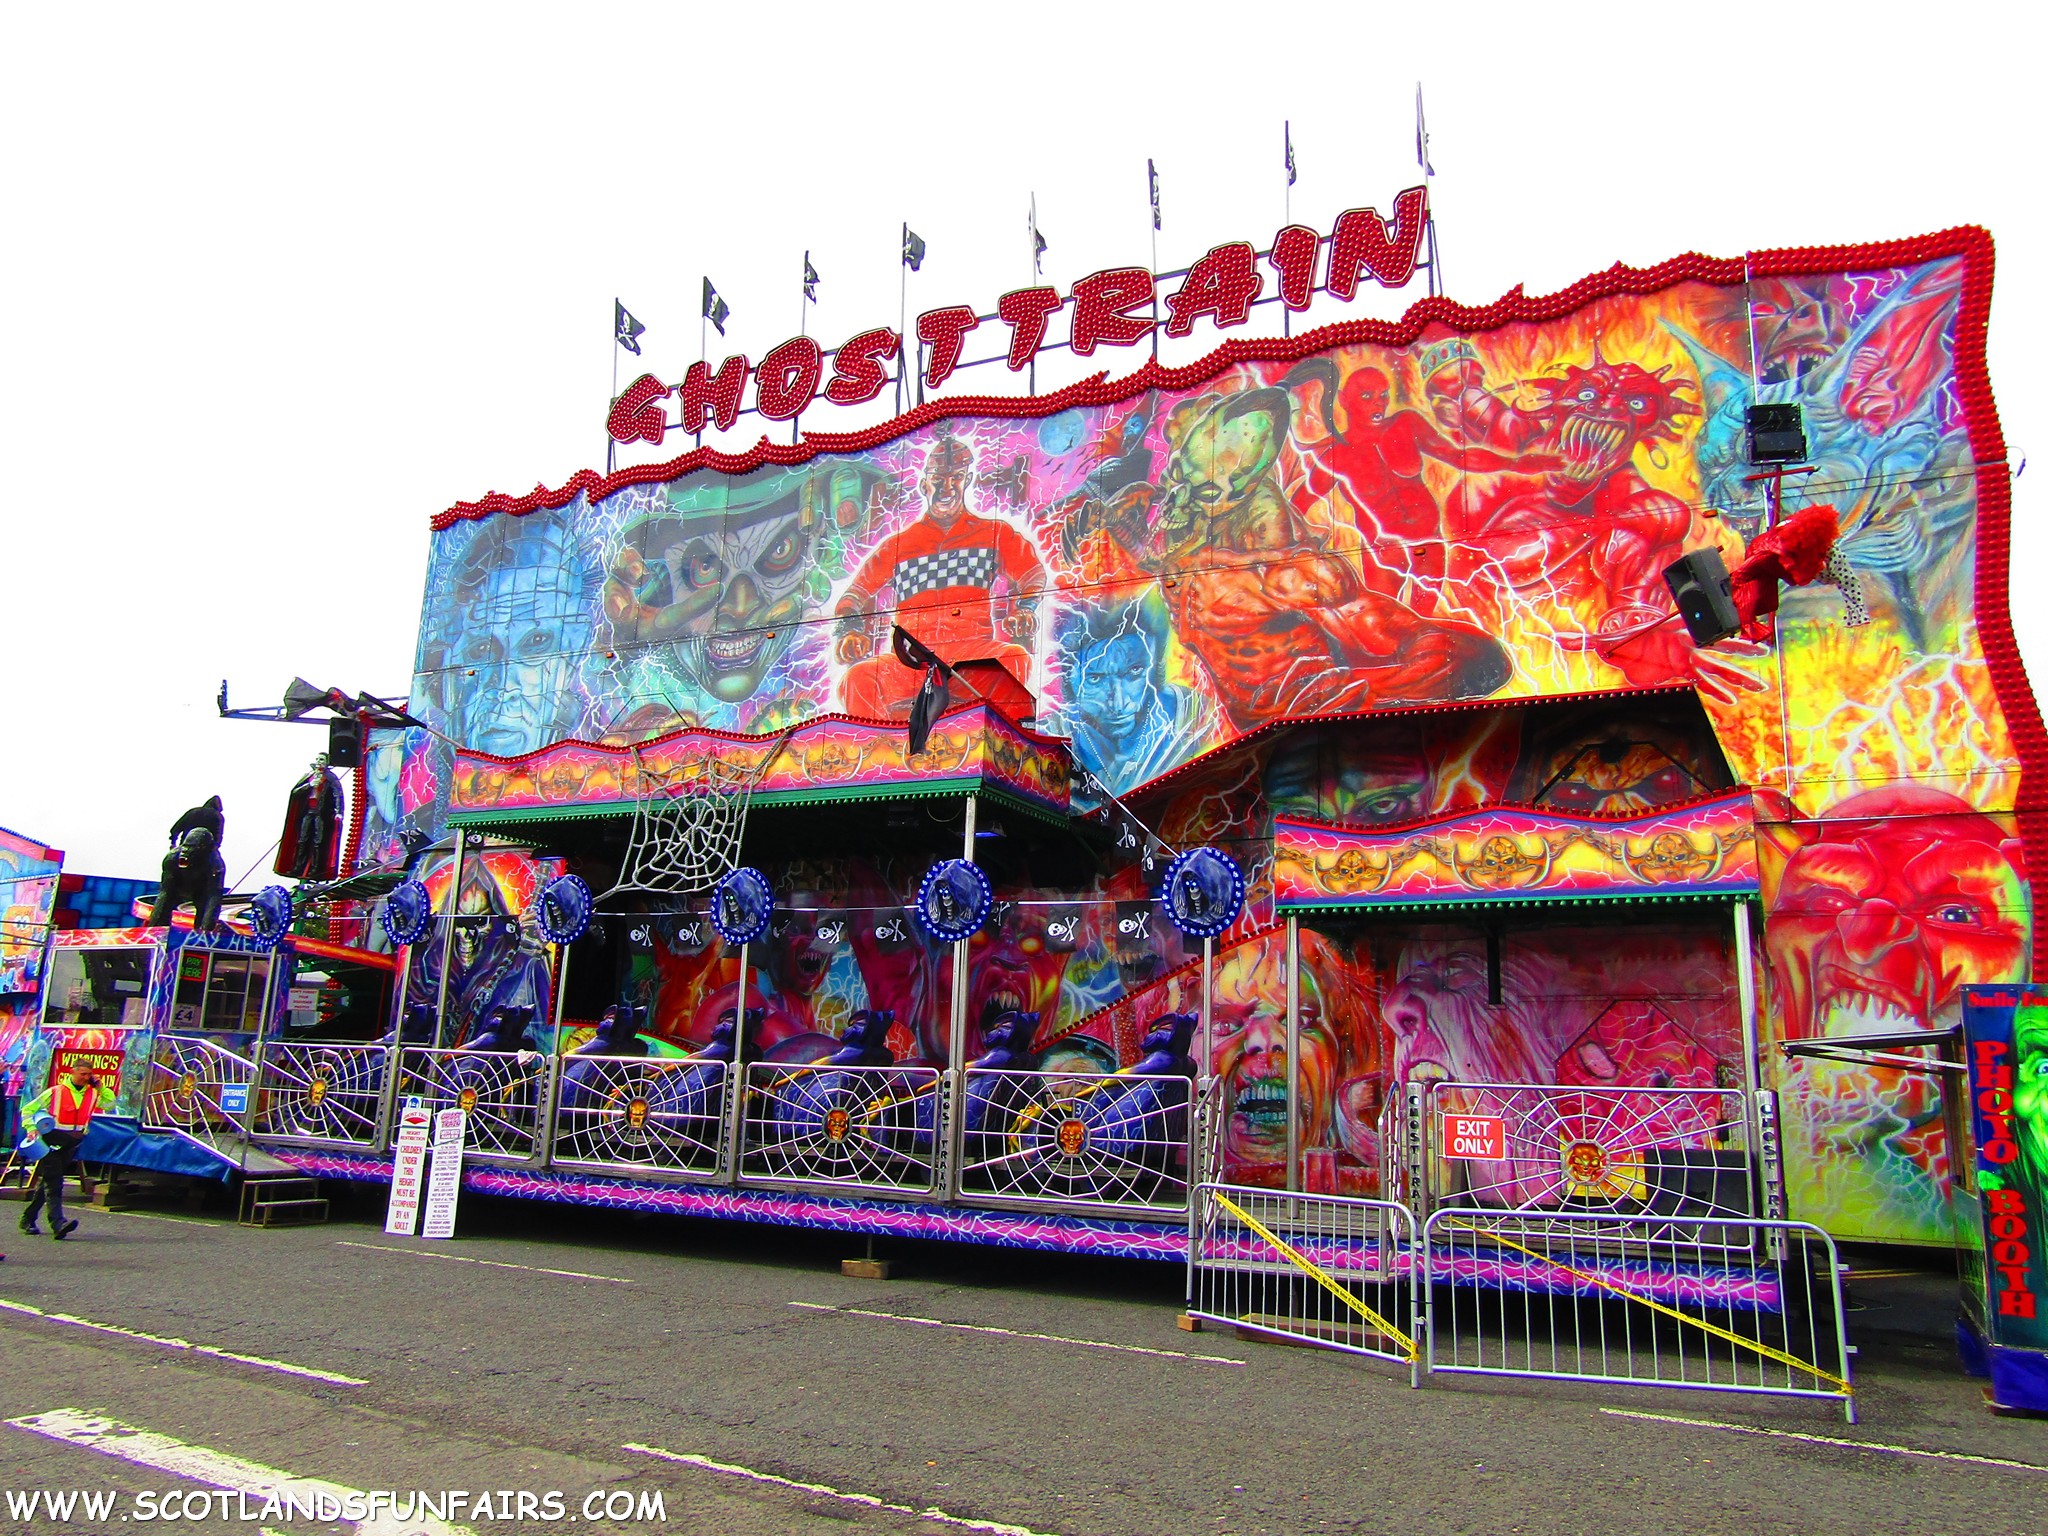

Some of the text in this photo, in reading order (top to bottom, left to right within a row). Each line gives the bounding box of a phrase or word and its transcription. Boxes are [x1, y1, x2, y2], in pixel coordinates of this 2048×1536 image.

[606, 185, 1428, 445] GHOST TRAIN
[182, 928, 272, 953] PAY HER
[1968, 992, 2016, 1007] Smile
[175, 1009, 193, 1021] £4
[223, 1089, 246, 1097] ENTRANCE
[227, 1099, 240, 1107] ONLY
[1974, 1041, 2019, 1164] PHOTO
[1075, 1103, 1081, 1114] 3
[1408, 1095, 1420, 1154] GHOST
[1456, 1120, 1490, 1136] EXIT
[939, 1080, 951, 1190] GHOST TRAIN
[401, 1145, 422, 1154] CHILDREN
[1453, 1138, 1493, 1154] ONLY
[402, 1157, 417, 1165] UNDER
[403, 1167, 413, 1175] THIS
[399, 1178, 416, 1186] HEIGHT
[396, 1188, 416, 1197] MUST BE
[395, 1210, 409, 1219] BY AN
[394, 1222, 408, 1230] ADULT
[1987, 1189, 2036, 1318] BOOTH
